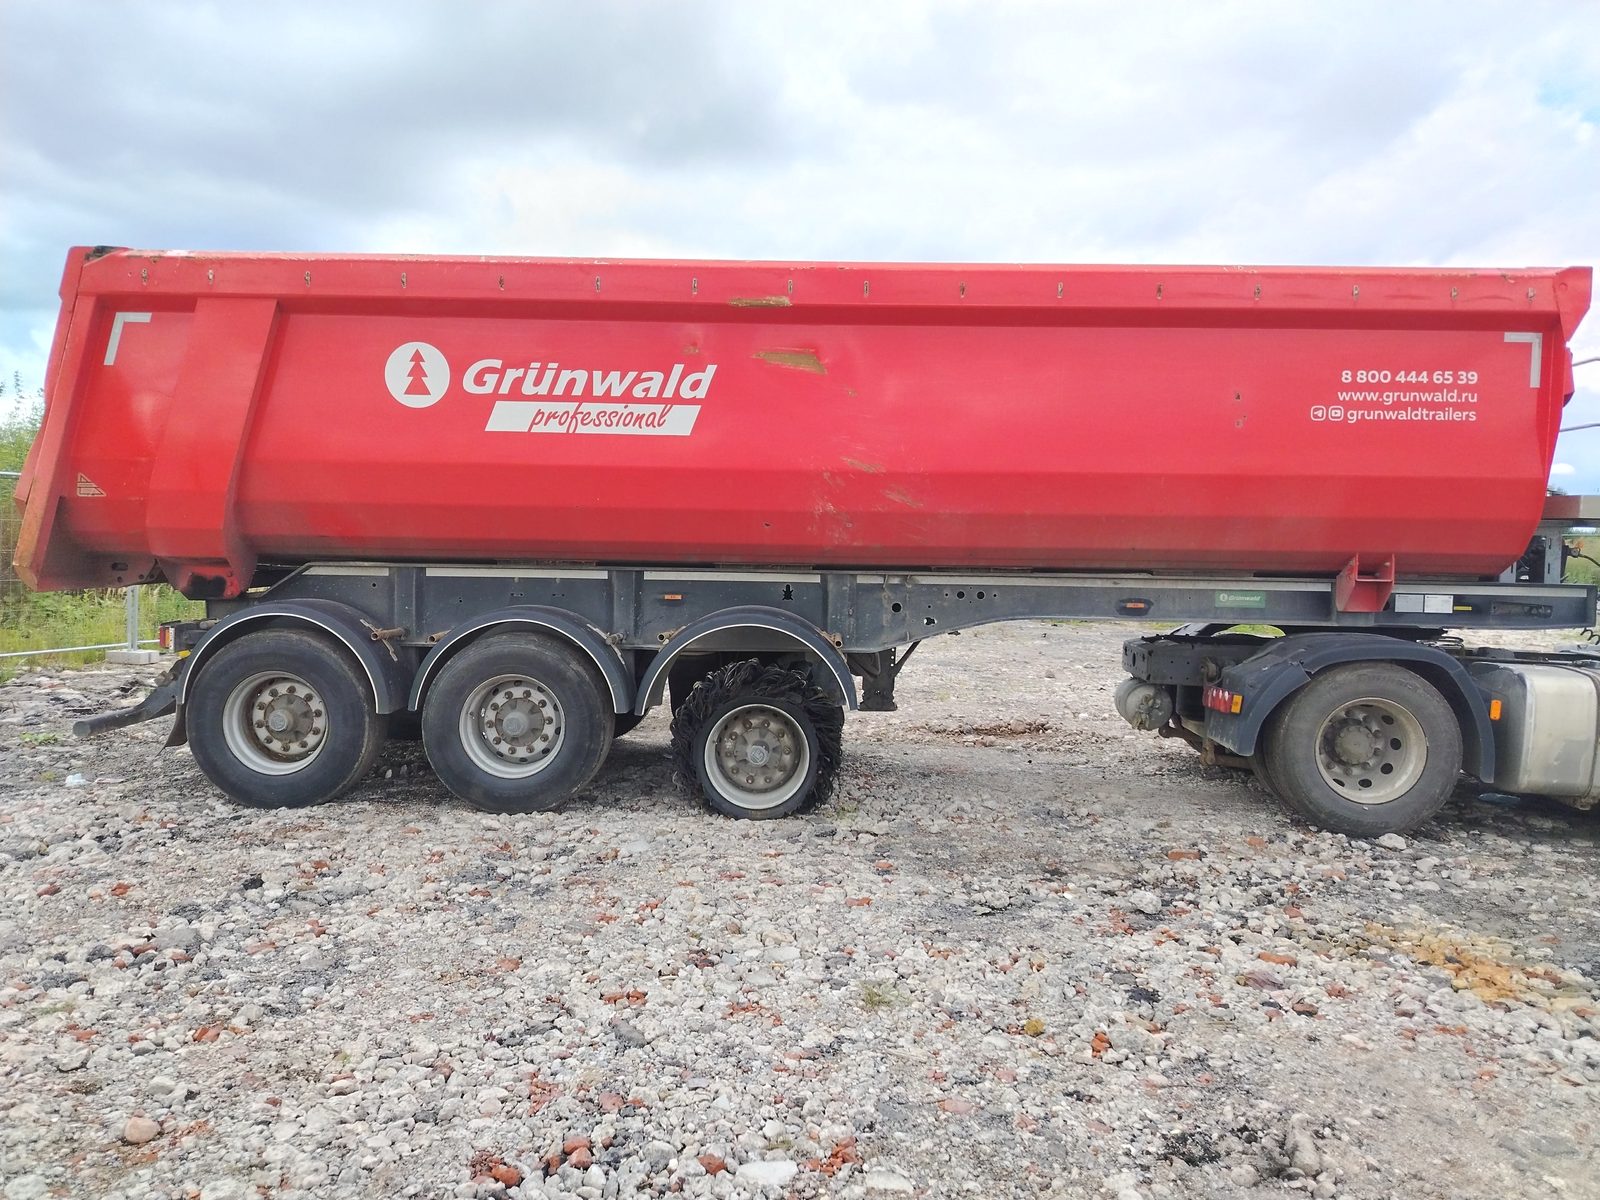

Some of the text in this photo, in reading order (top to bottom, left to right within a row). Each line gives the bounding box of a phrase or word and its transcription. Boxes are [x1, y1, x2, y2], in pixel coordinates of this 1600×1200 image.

[462, 359, 718, 399] Grünwald
[1341, 370, 1478, 385] 8 800 444 65 39
[1337, 389, 1478, 405] www.grunwald.ru
[529, 402, 674, 434] professional
[1347, 407, 1477, 424] grunwaldtrailers
